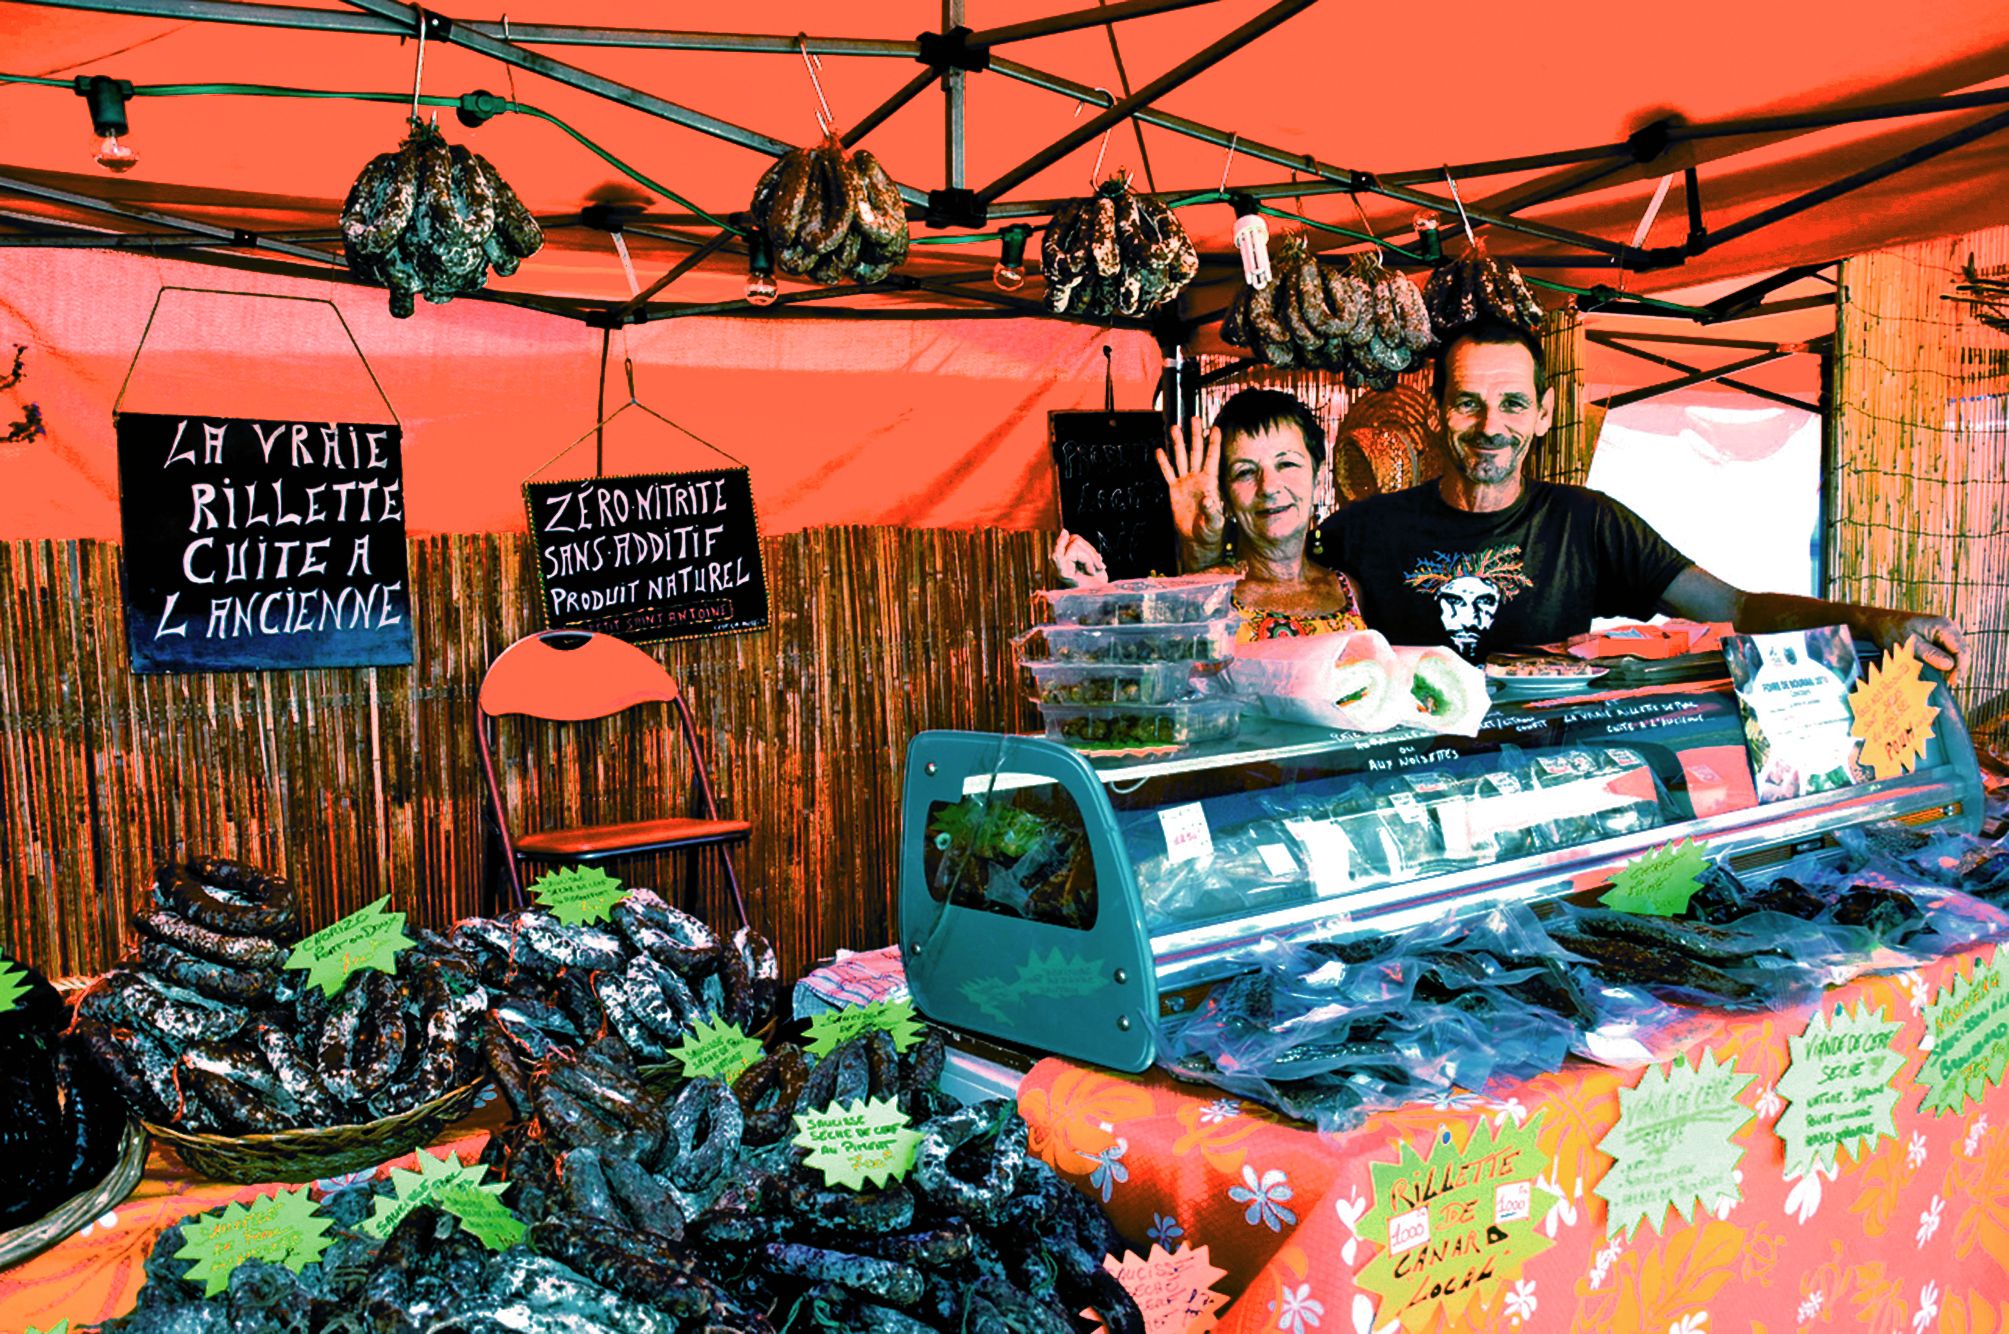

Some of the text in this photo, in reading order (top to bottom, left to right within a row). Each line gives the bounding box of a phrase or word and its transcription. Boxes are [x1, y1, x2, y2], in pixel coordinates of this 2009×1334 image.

[164, 419, 388, 470] LA VRAIE
[189, 477, 402, 534] RILLETTE
[544, 478, 727, 533] ZÉRO NITRITE
[182, 534, 373, 584] CUITE A
[544, 524, 724, 580] SANS ADDITIF
[153, 580, 401, 641] L ANCIENNE
[550, 556, 750, 616] PRODUIT NATUREL
[1806, 1033, 1848, 1061] VIANDE
[1848, 1034, 1862, 1053] DE
[1390, 1145, 1521, 1212] RILLETTE
[1498, 1193, 1526, 1213] 1000
[1391, 1224, 1425, 1248] 1000
[1435, 1200, 1479, 1231] DE
[1393, 1226, 1510, 1279] CANARD
[1406, 1255, 1497, 1308] LOCAL
